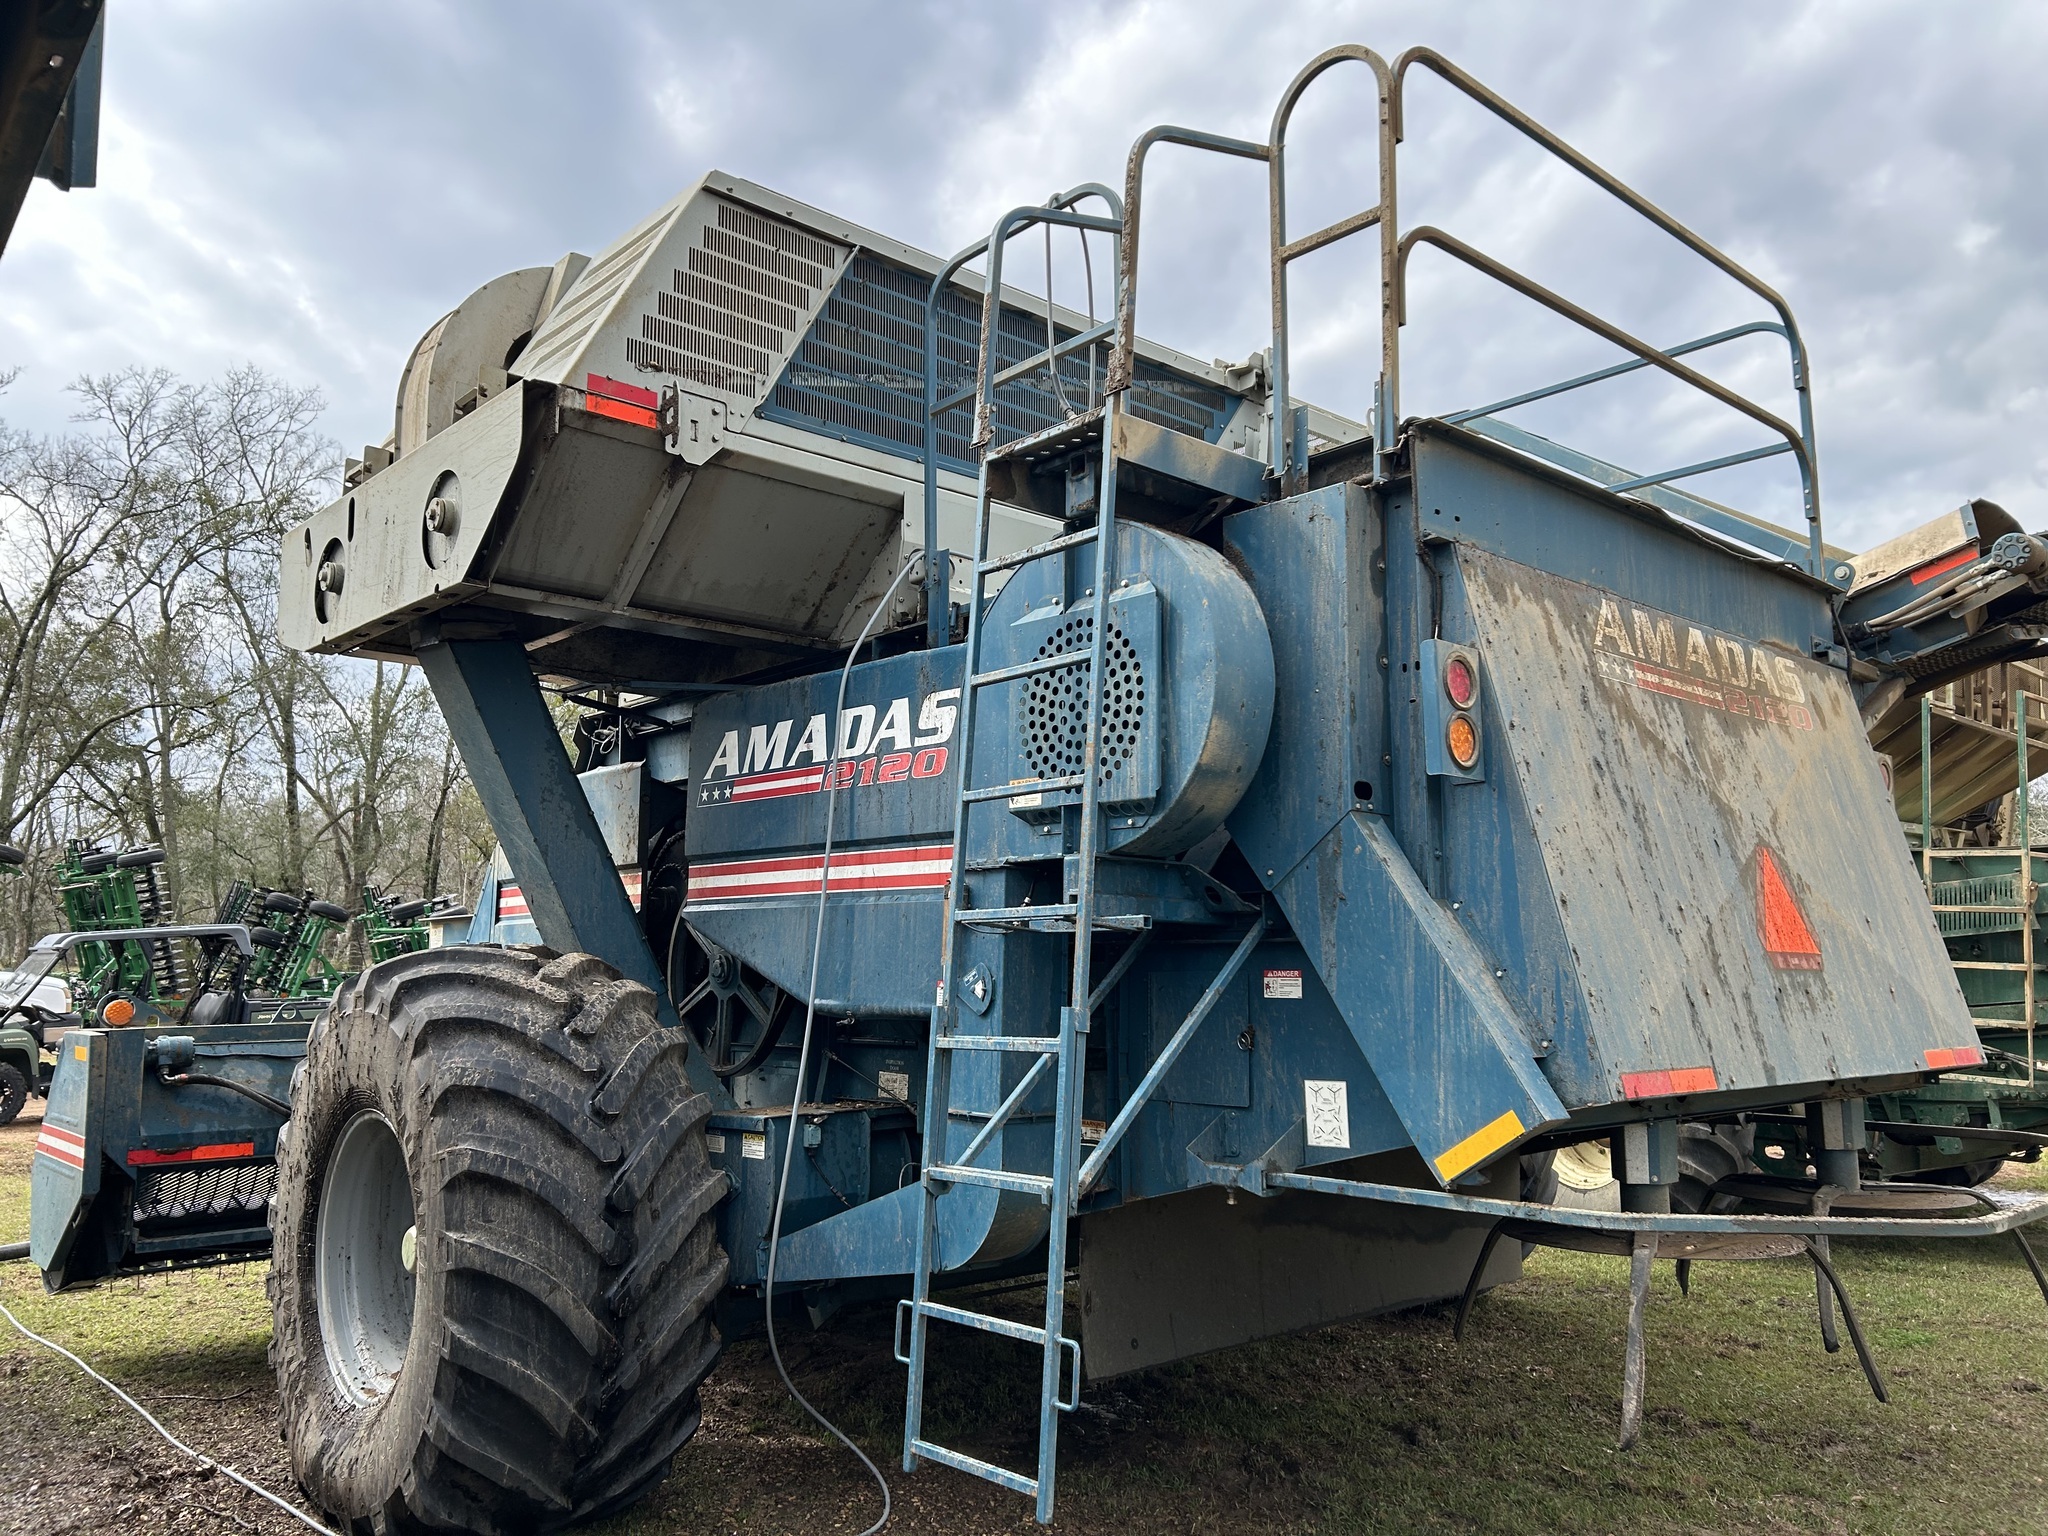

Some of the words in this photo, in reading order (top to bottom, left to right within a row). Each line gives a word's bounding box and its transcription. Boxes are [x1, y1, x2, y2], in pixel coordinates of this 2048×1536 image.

[1594, 598, 1806, 704] AMADAS
[703, 687, 962, 780] AMADAS
[1722, 686, 1814, 731] 2120
[822, 746, 949, 791] 2120
